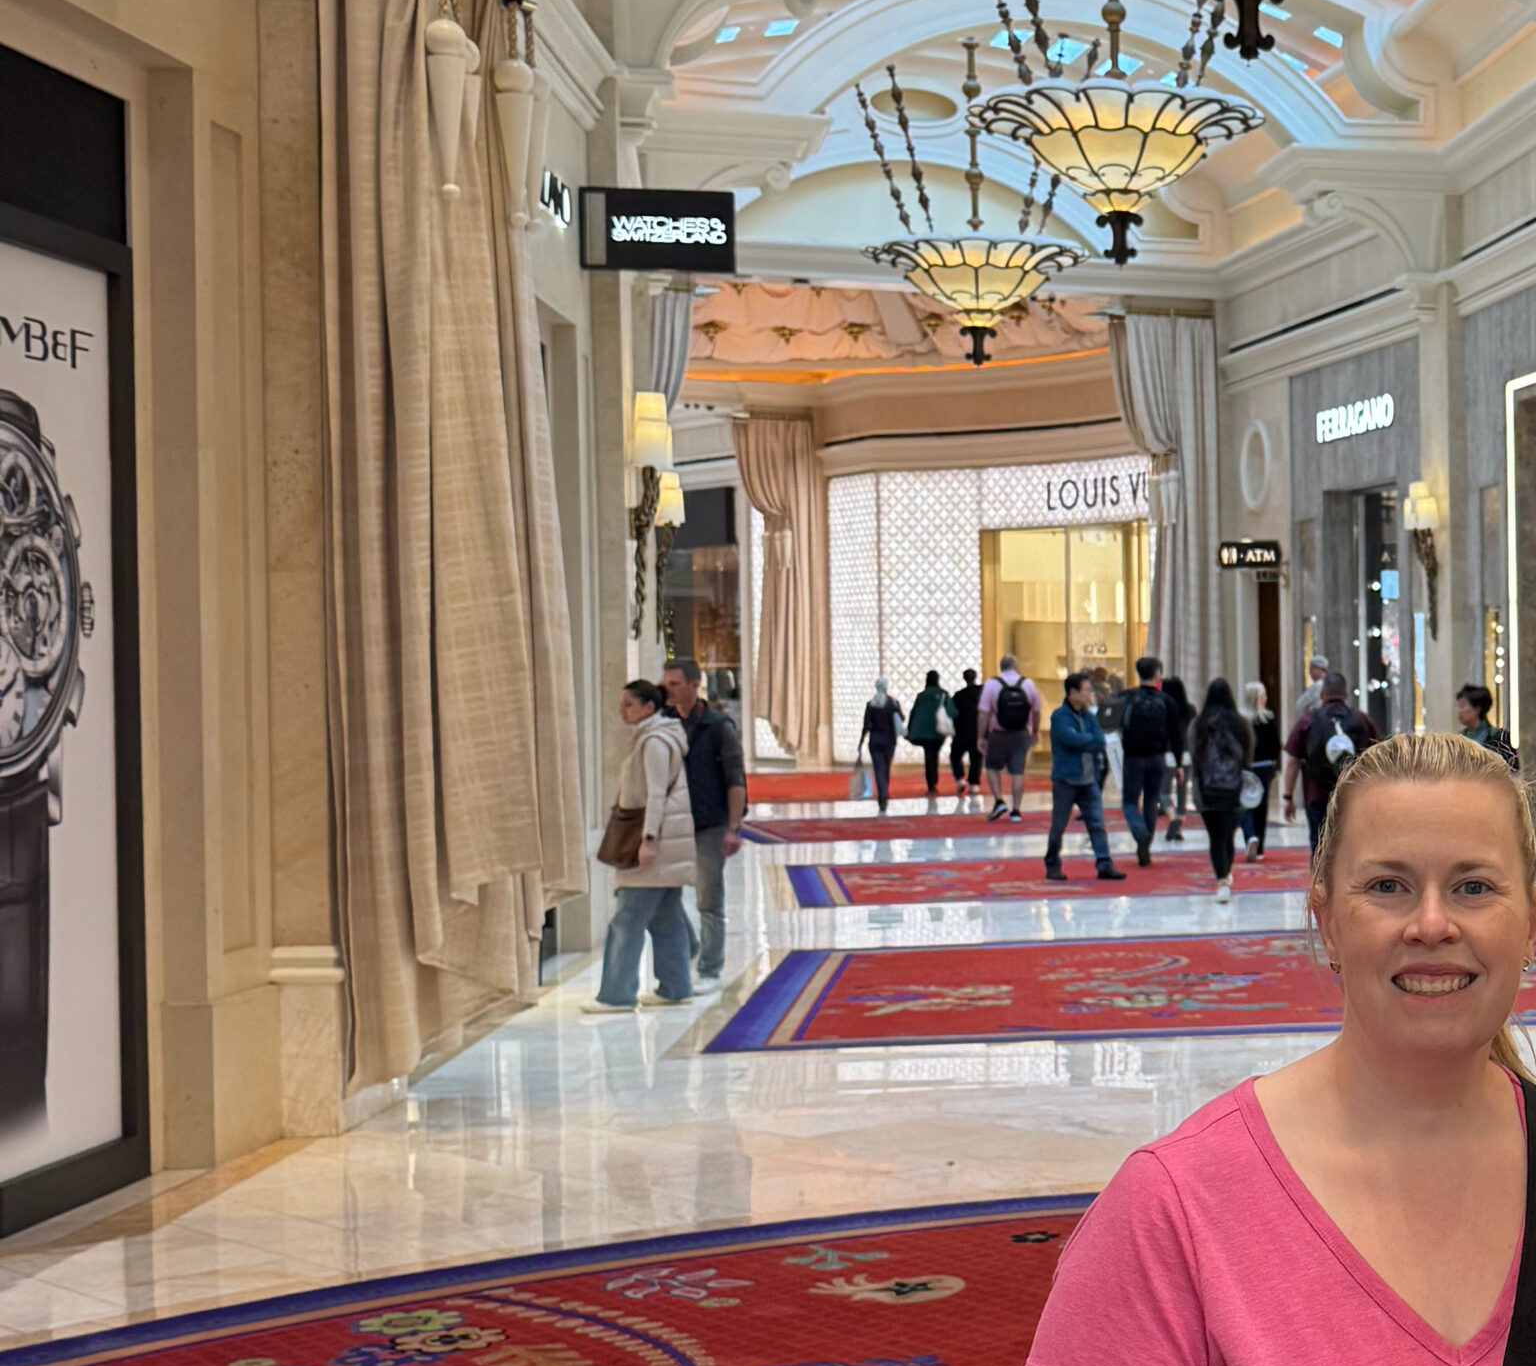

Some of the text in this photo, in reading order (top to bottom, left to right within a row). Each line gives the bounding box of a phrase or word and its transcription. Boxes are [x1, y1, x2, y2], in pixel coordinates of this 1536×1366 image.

[611, 215, 709, 232] WATCHES
[611, 229, 727, 245] SWITZERLAND
[1316, 392, 1395, 444] FERRAGAMO
[1046, 475, 1121, 512] LOUIS
[1245, 549, 1276, 563] ATM
